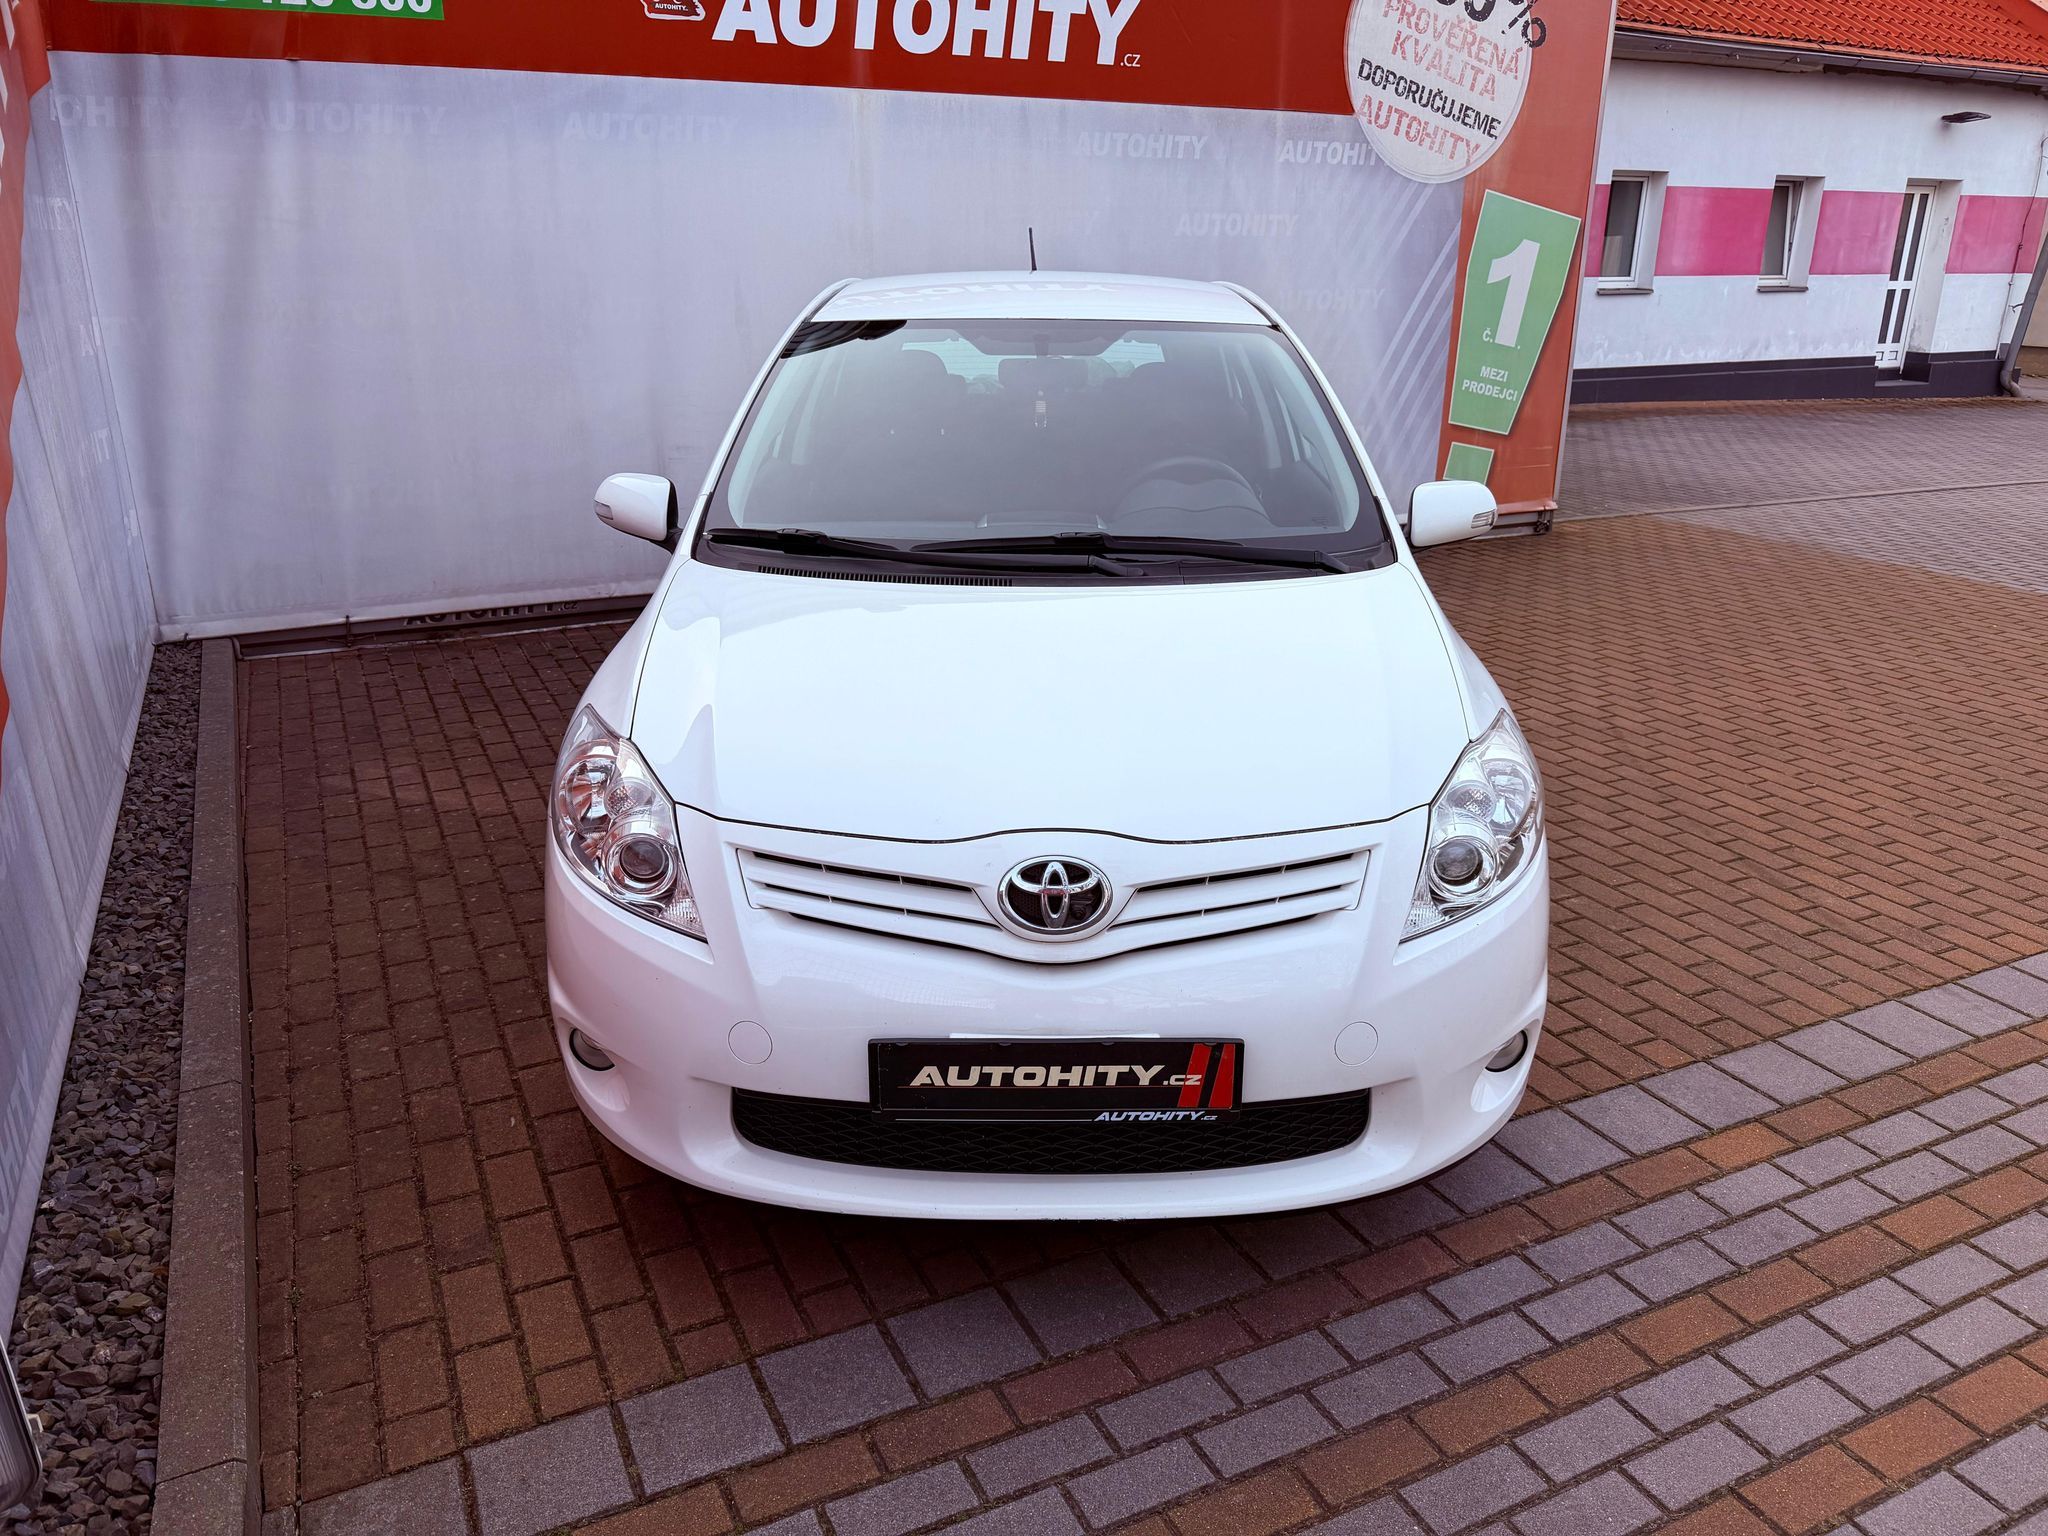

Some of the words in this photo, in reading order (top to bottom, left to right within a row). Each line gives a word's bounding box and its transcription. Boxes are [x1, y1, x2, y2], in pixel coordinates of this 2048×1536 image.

[1382, 0, 1523, 81] PROVĚŘENÁ
[1391, 29, 1496, 101] KVALITA
[1357, 57, 1502, 140] DOPORUČUJEME
[1077, 131, 1209, 161] AUTOHITY
[1278, 139, 1388, 168] AUTOHIT
[1355, 94, 1481, 168] AUTOHITY
[1462, 379, 1518, 402] PRODEJCI
[1480, 365, 1509, 382] MEZI
